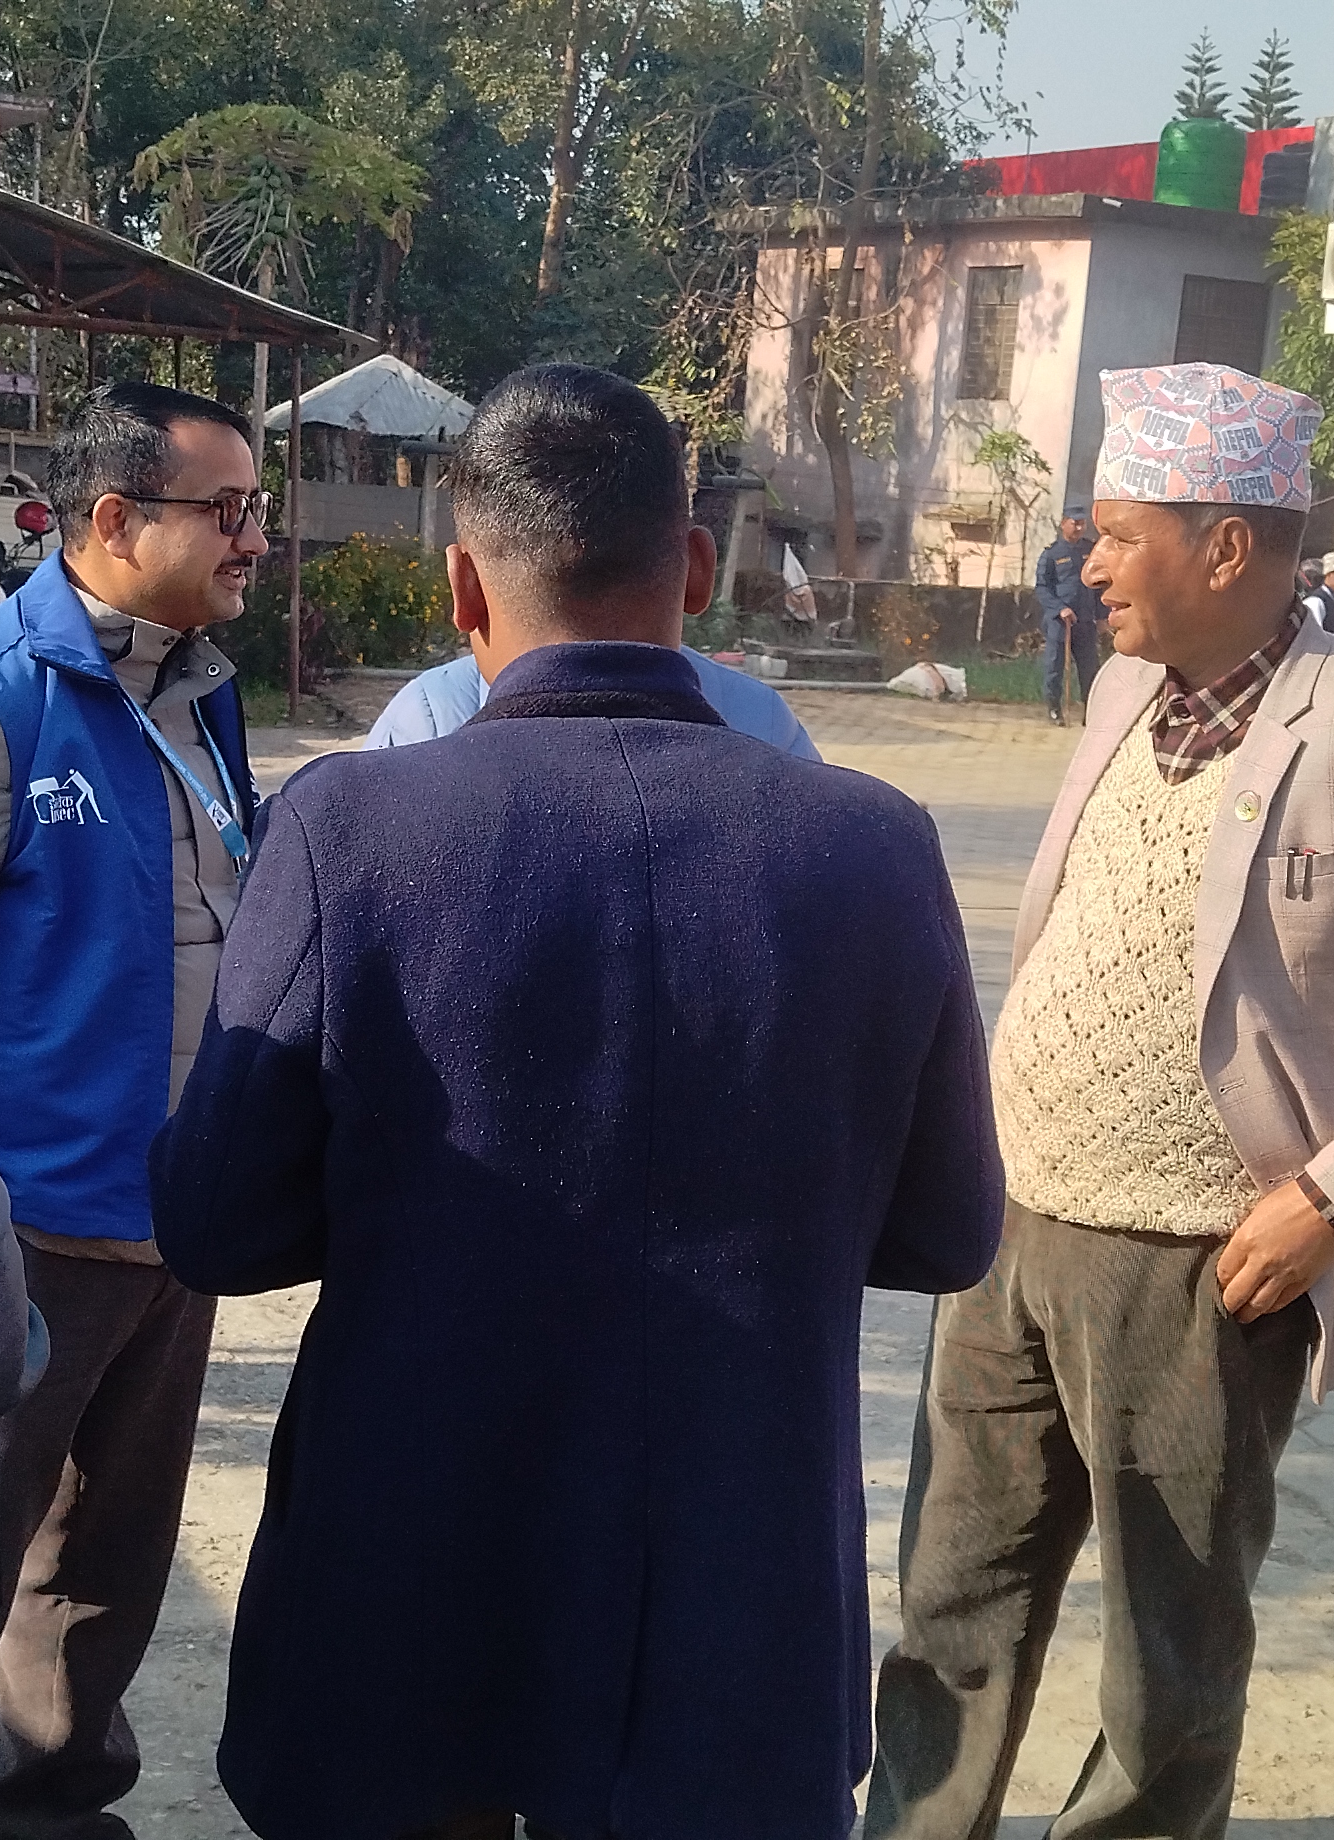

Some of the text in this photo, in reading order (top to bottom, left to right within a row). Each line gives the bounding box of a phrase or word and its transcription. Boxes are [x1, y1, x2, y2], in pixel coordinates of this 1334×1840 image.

[1141, 410, 1190, 446] NEPAL
[1213, 426, 1263, 453] NEPAL
[1121, 459, 1167, 494] NEPAL
[1227, 474, 1276, 502] NEPAL
